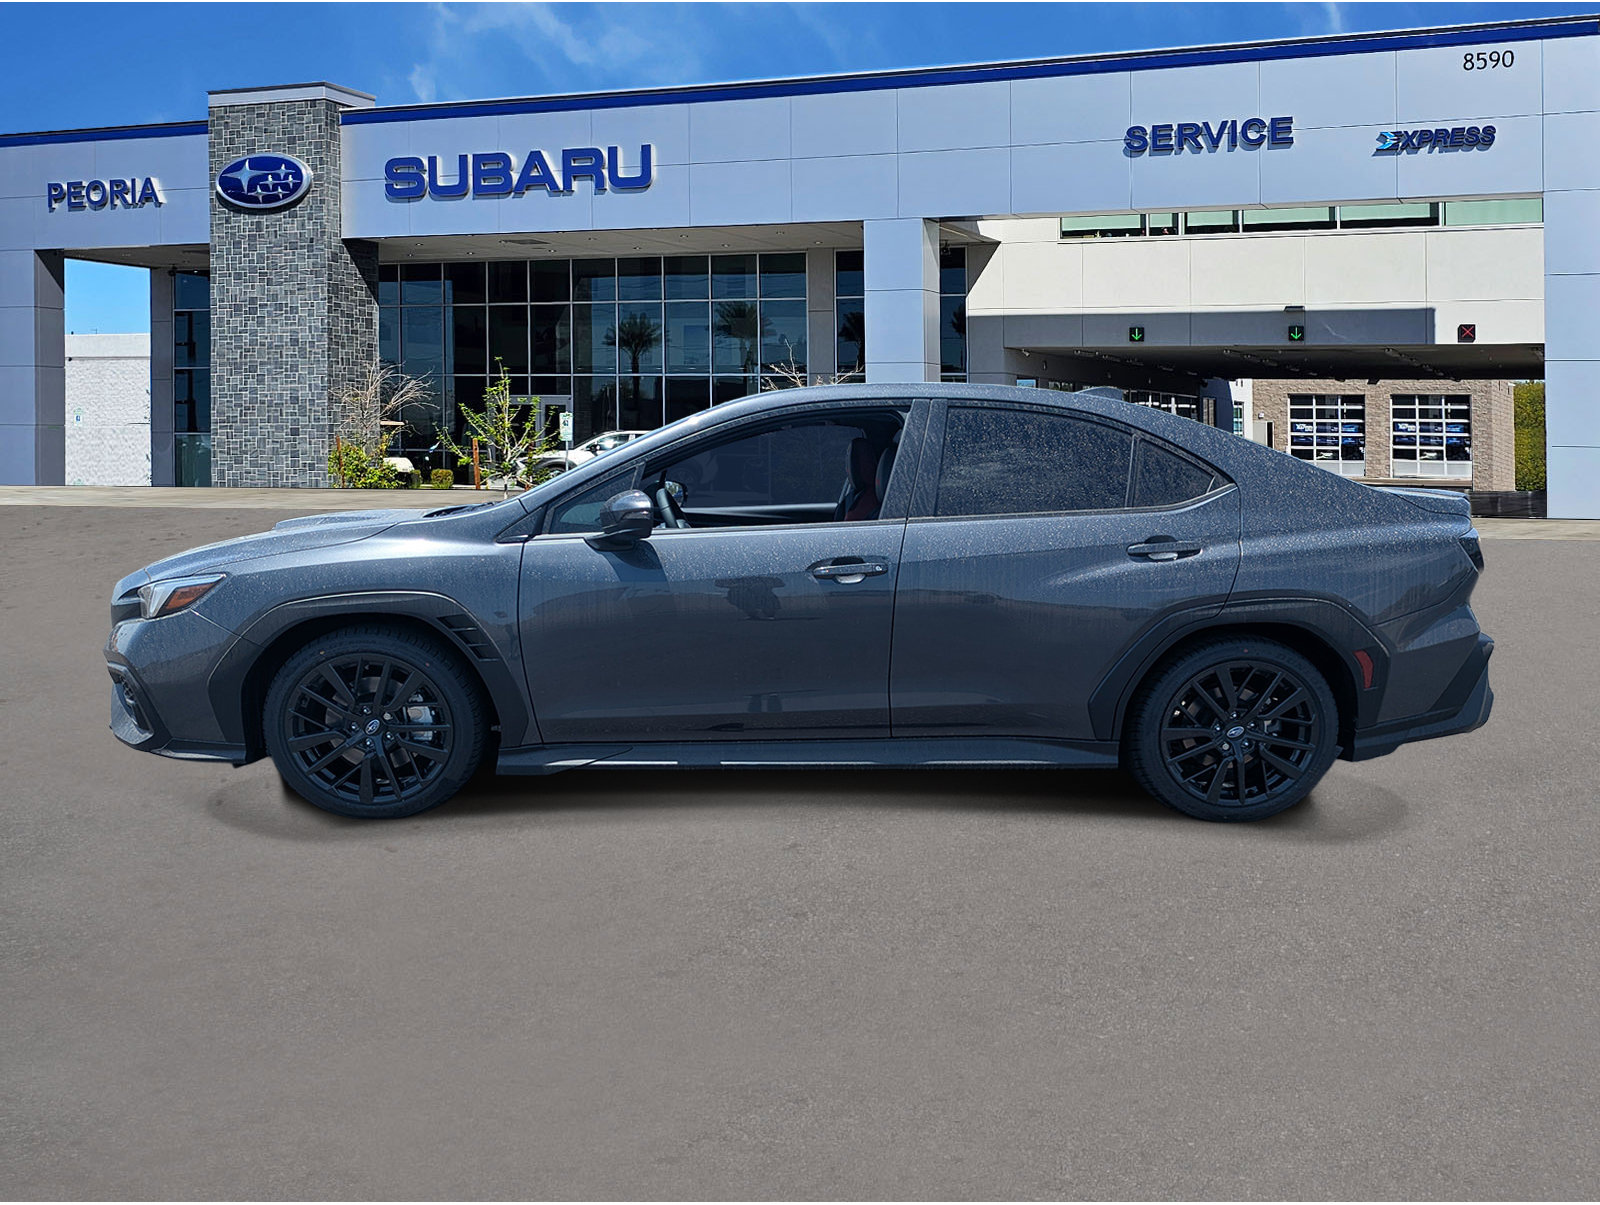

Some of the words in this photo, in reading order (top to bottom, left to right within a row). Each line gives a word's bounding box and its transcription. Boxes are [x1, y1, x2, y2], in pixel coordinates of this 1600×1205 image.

[1463, 50, 1514, 71] 8590
[1125, 116, 1294, 152] SERVICE
[1375, 126, 1496, 151] EXPRESS
[385, 144, 652, 199] SUBARU
[47, 177, 162, 211] PEORIA
